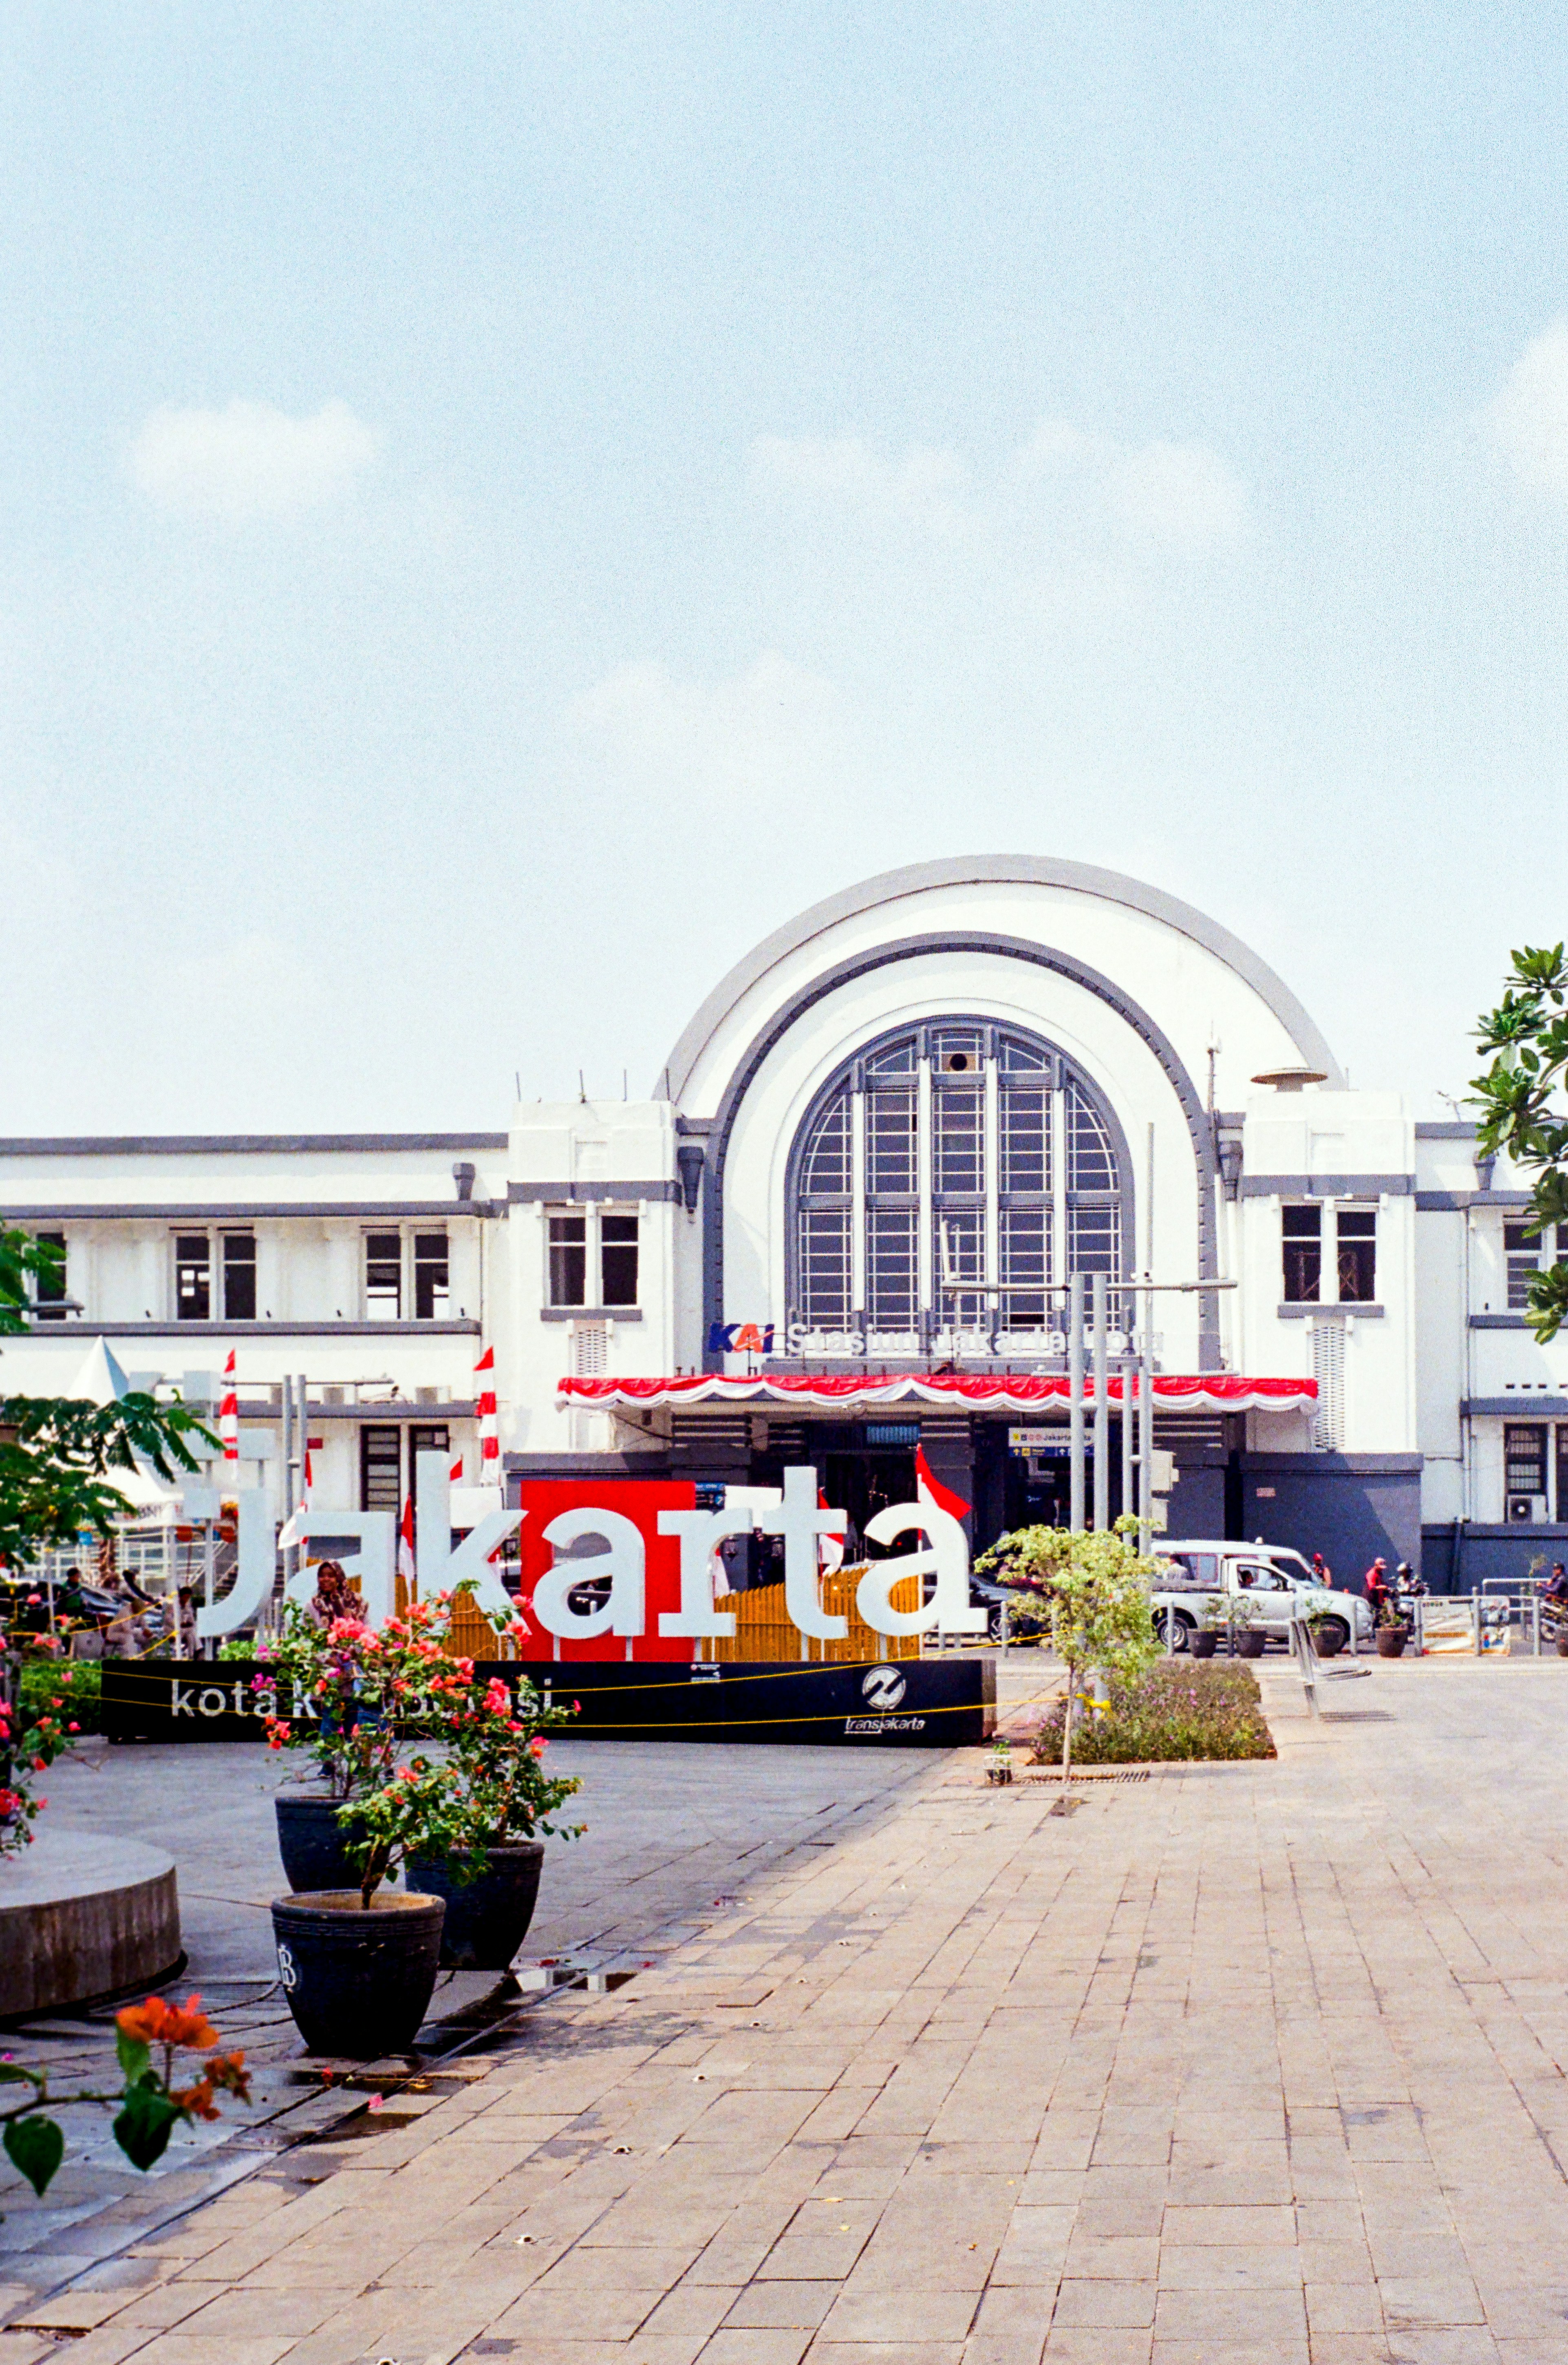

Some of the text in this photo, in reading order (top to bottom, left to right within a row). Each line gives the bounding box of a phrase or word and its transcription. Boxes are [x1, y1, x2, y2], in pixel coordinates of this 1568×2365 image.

[708, 1323, 775, 1354] KAI
[787, 1323, 920, 1354] Stasiun
[931, 1323, 1065, 1354] Jakarta
[197, 1451, 988, 1639] Jakarta
[171, 1679, 277, 1718] kota
[844, 1716, 926, 1734] transjakarta
